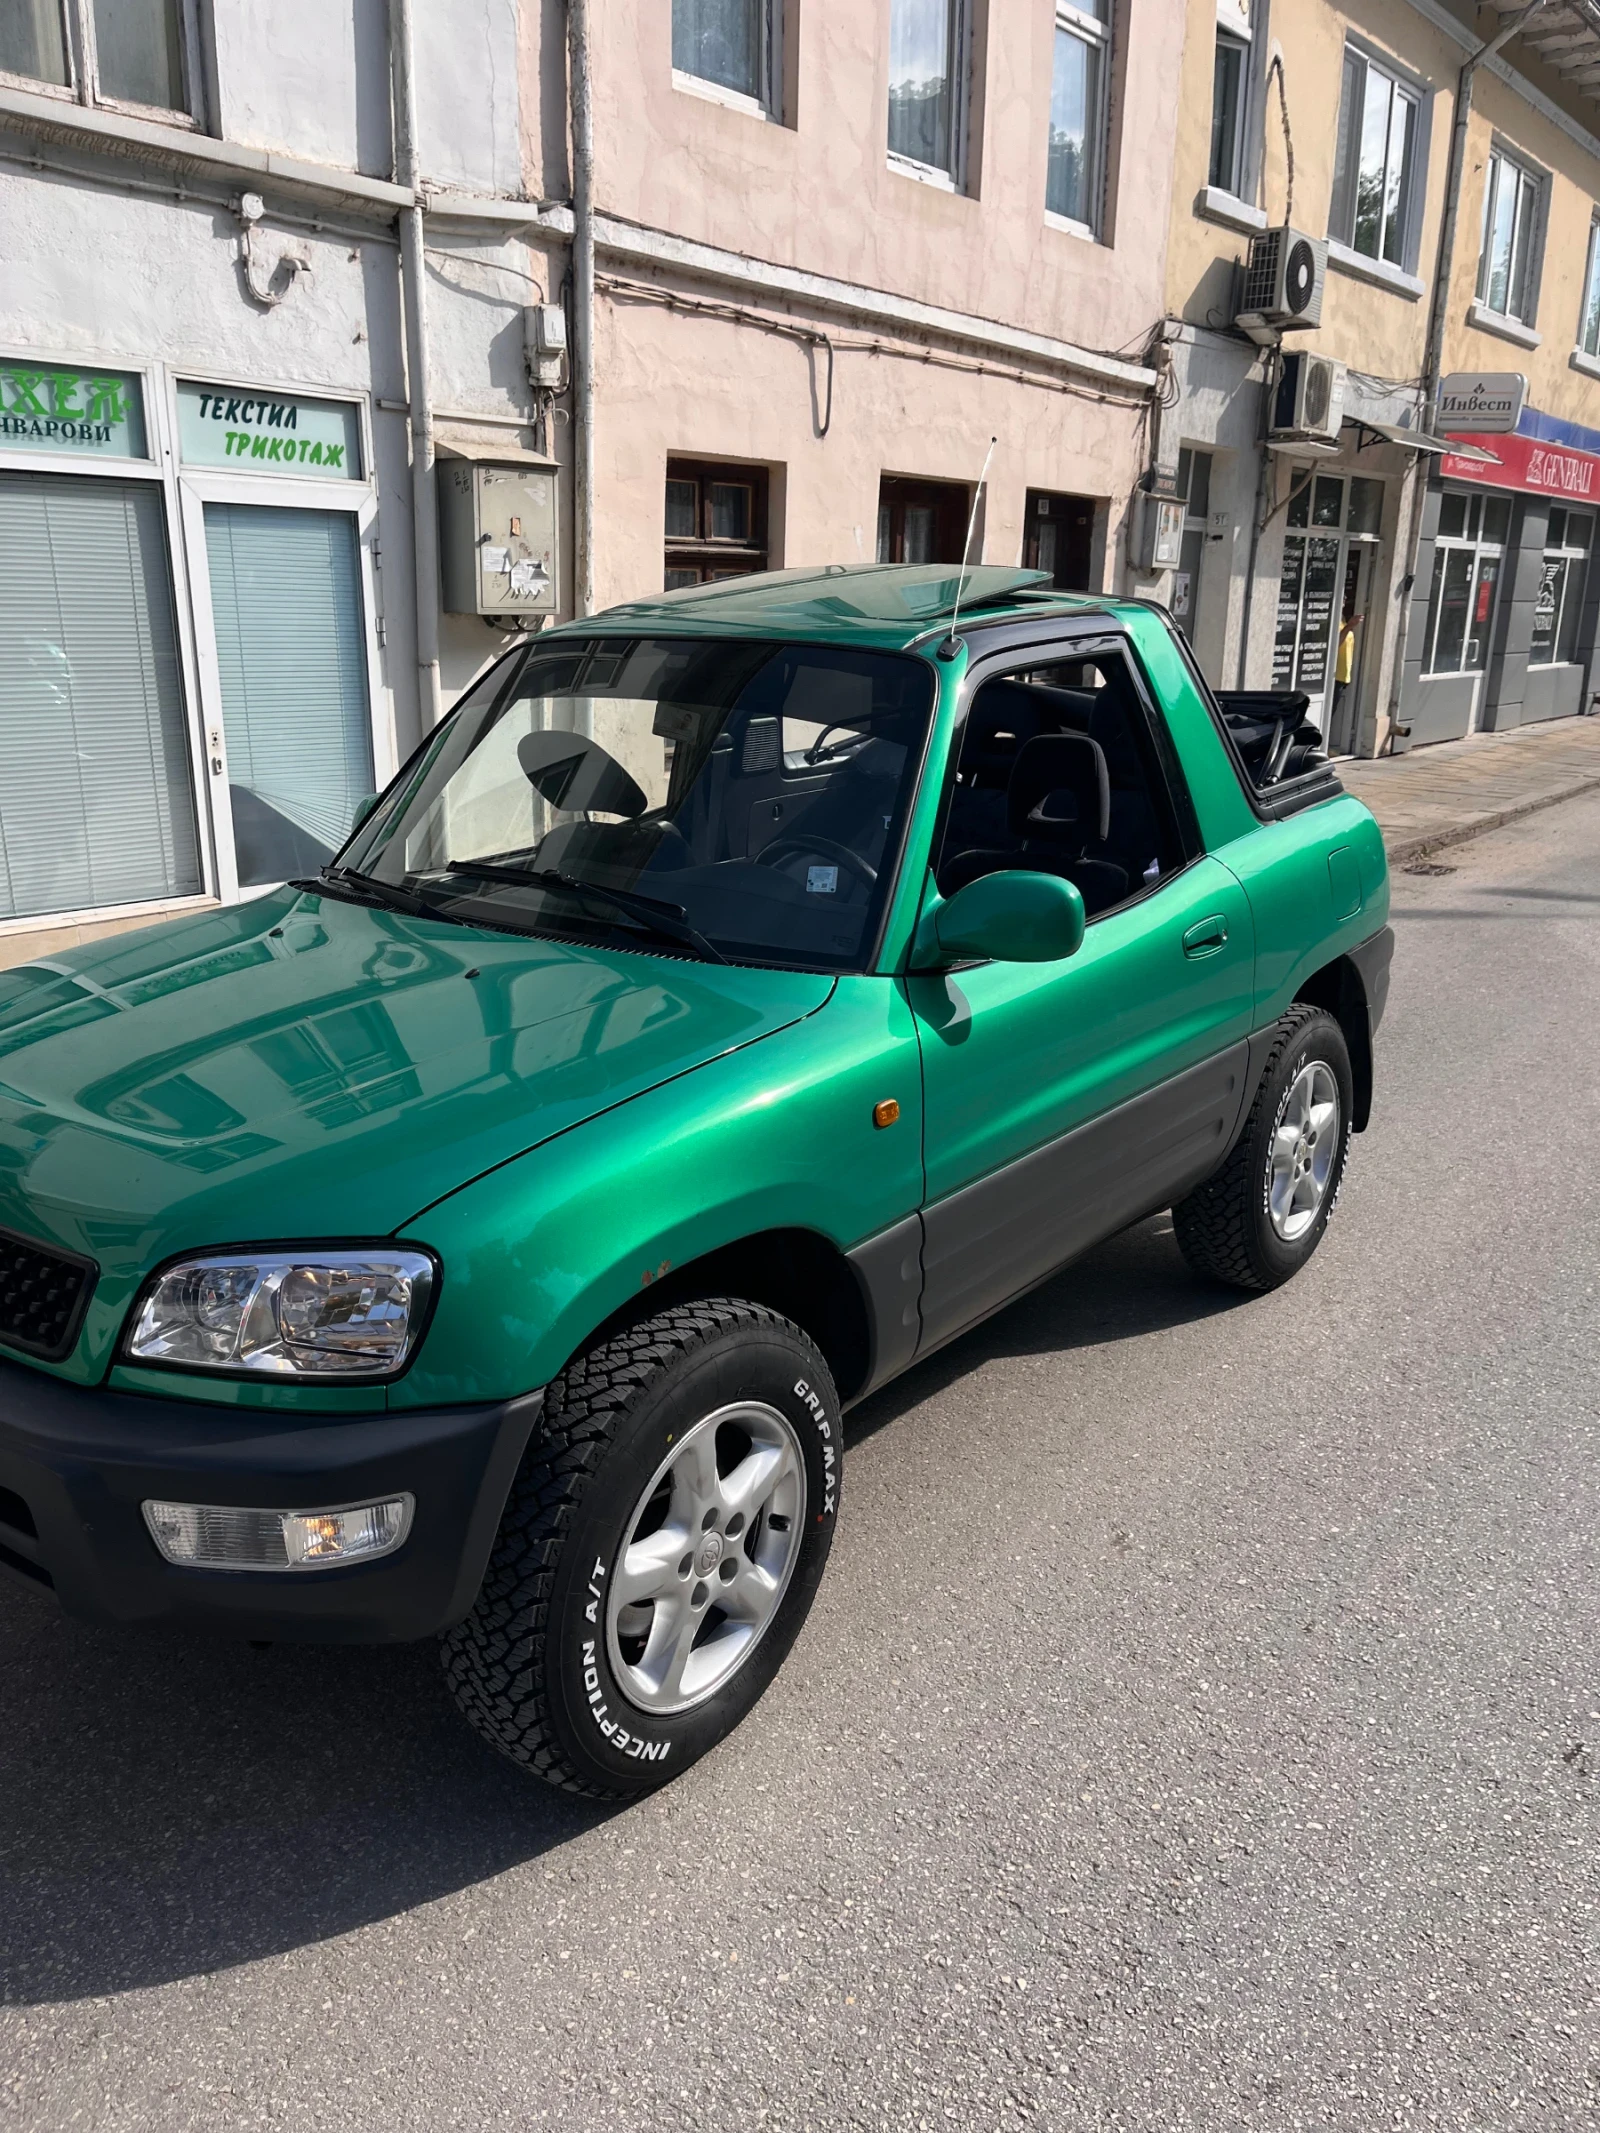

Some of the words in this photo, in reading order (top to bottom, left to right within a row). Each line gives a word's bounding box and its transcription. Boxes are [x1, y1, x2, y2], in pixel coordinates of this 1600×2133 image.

[199, 394, 297, 430] ТЕКСТИЛ
[1440, 396, 1512, 411] Инвест
[225, 431, 345, 468] ТРИКОТАЖ
[1543, 453, 1594, 493] GENERALI
[585, 1556, 606, 1624] A/T
[582, 1640, 671, 1760] INCEPTION
